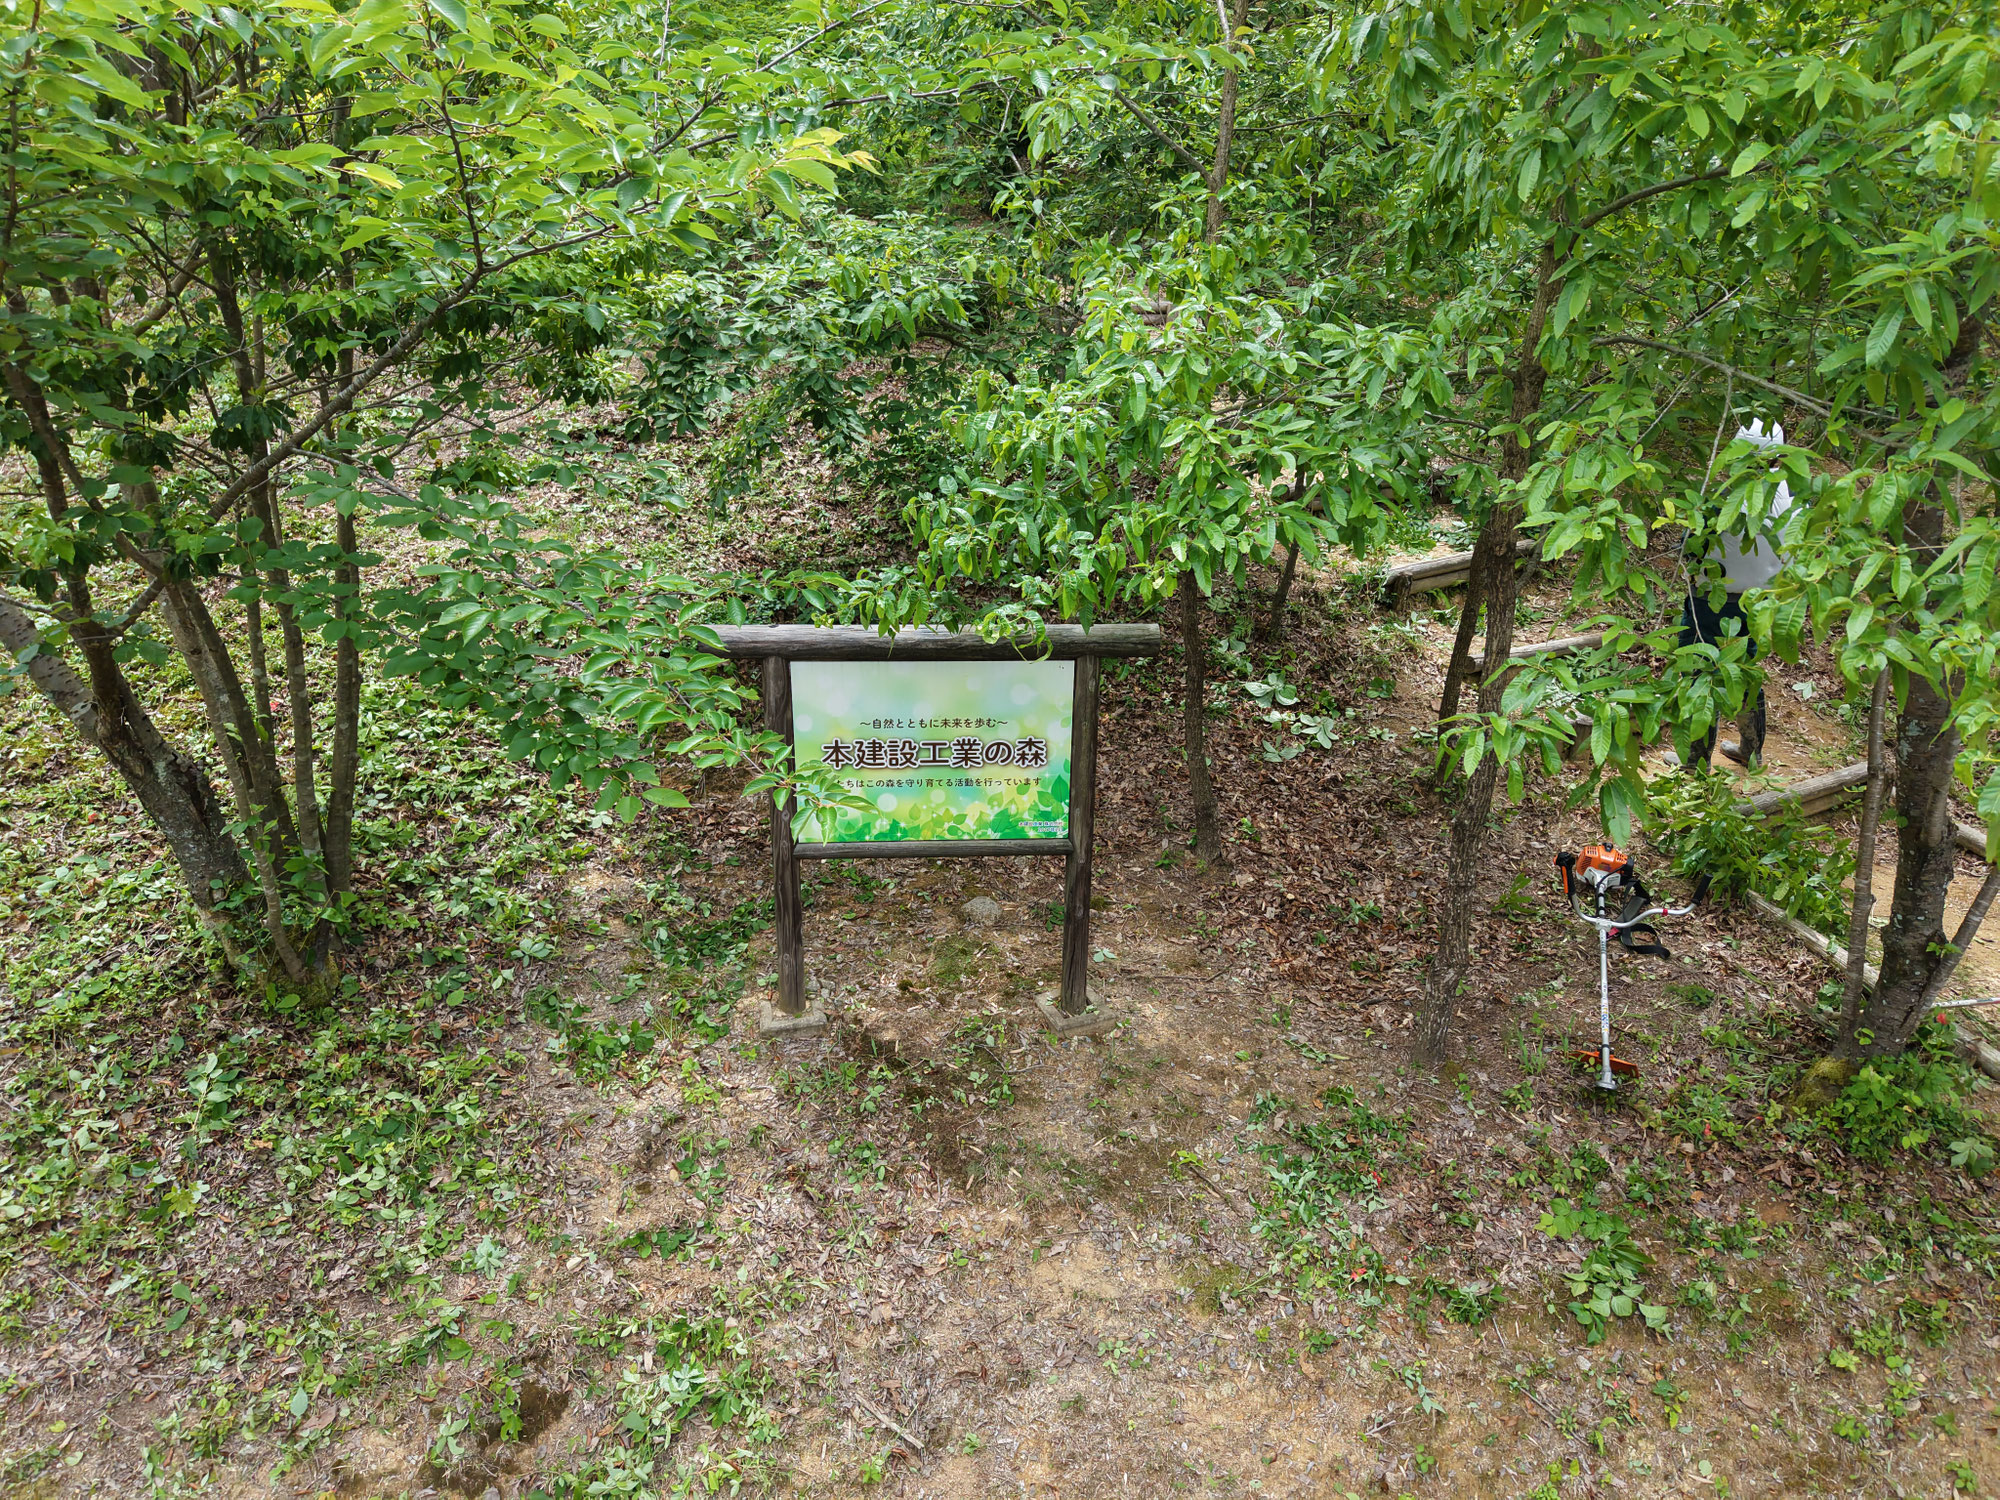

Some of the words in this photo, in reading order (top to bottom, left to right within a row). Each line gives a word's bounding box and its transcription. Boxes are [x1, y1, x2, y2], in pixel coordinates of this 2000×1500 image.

[821, 737, 1047, 769] 本建設工業の森
[835, 777, 1042, 788] たちはこの森を守り育てる活動を行っています
